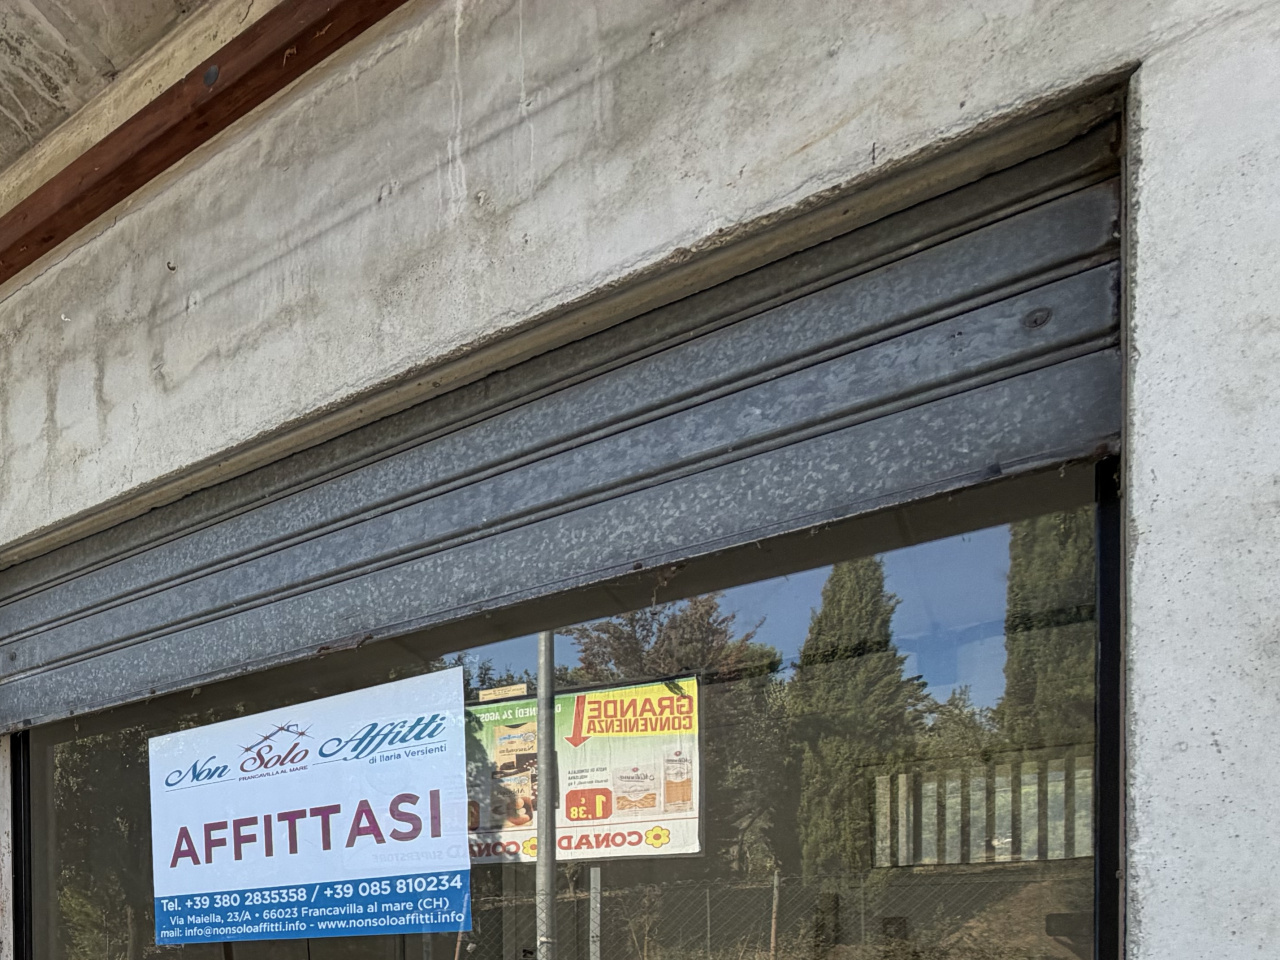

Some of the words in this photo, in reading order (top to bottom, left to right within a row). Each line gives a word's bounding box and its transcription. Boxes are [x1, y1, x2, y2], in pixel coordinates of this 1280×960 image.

[164, 755, 231, 787] Non
[239, 742, 310, 773] Solo
[318, 713, 447, 761] Affitti
[368, 755, 377, 765] di
[379, 751, 402, 763] Ilaria
[404, 743, 447, 758] Versienti
[238, 771, 280, 782] FRANCAVILLA
[289, 765, 309, 773] MARE
[170, 789, 442, 868] AFFITTASI
[161, 898, 182, 912] Tel.
[185, 896, 210, 909] +39
[213, 893, 240, 908] 380
[244, 887, 307, 906] 2835358
[323, 883, 354, 899] +39
[358, 880, 391, 897] 085
[396, 874, 463, 894] 810234
[160, 928, 183, 938] mail:
[184, 920, 307, 938] info@nonsoloaffitti.info
[317, 911, 465, 930] www.nonsoloaffitti.info
[170, 915, 184, 926] Via
[187, 913, 224, 924] Maiella,
[226, 910, 252, 923] 23/A
[262, 907, 298, 920] 66023
[301, 903, 364, 918] Francavilla
[366, 901, 378, 913] al
[381, 900, 414, 912] mare
[417, 897, 450, 911] (CH)
